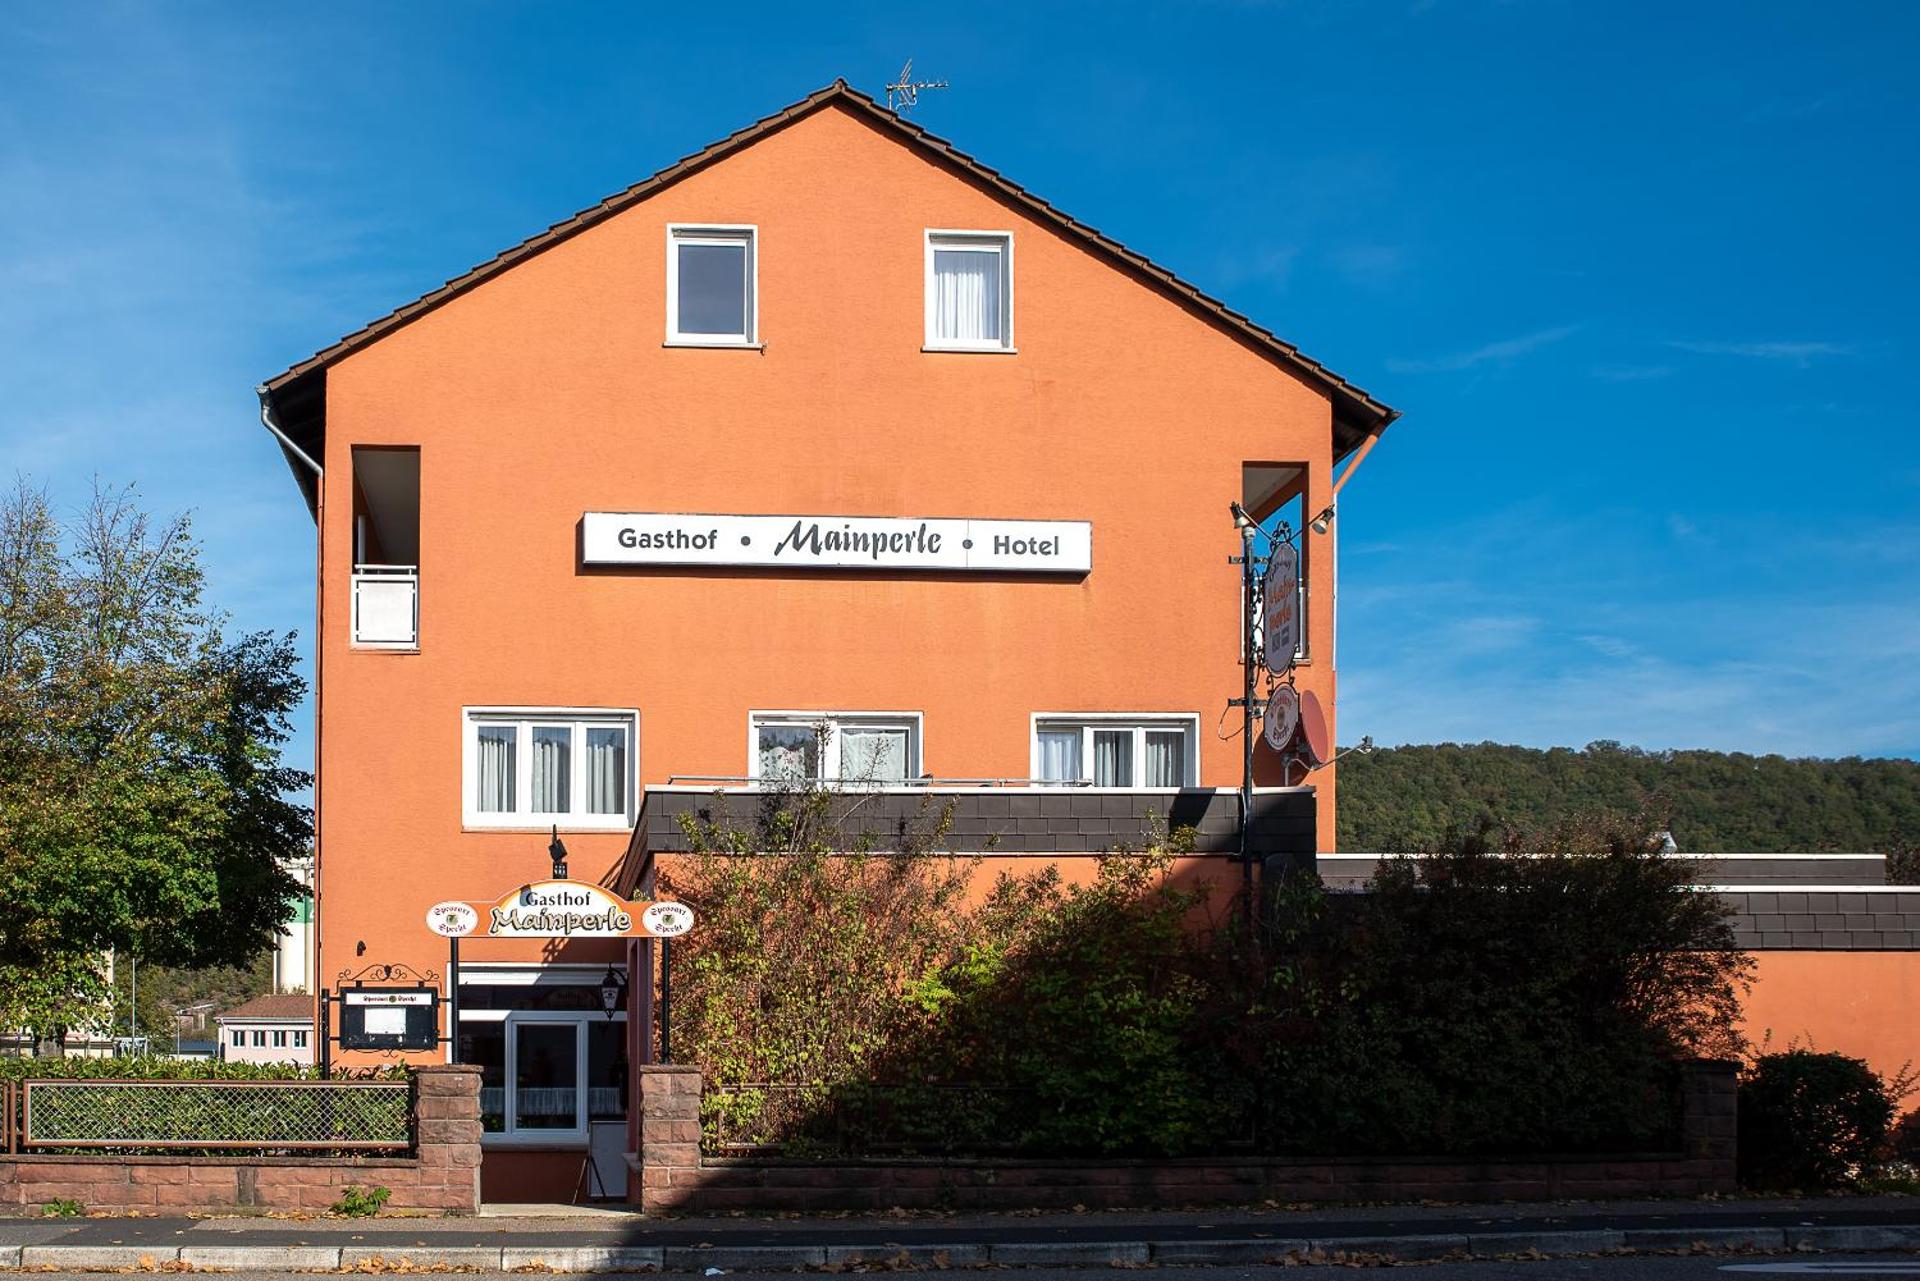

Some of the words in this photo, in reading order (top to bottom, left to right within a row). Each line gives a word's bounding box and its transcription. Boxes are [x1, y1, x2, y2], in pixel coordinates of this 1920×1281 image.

[618, 528, 717, 549] Gasthof
[774, 520, 942, 560] Mainperle
[994, 535, 1059, 555] Hotel
[527, 892, 591, 906] Gasthof
[490, 908, 631, 934] Mainperle
